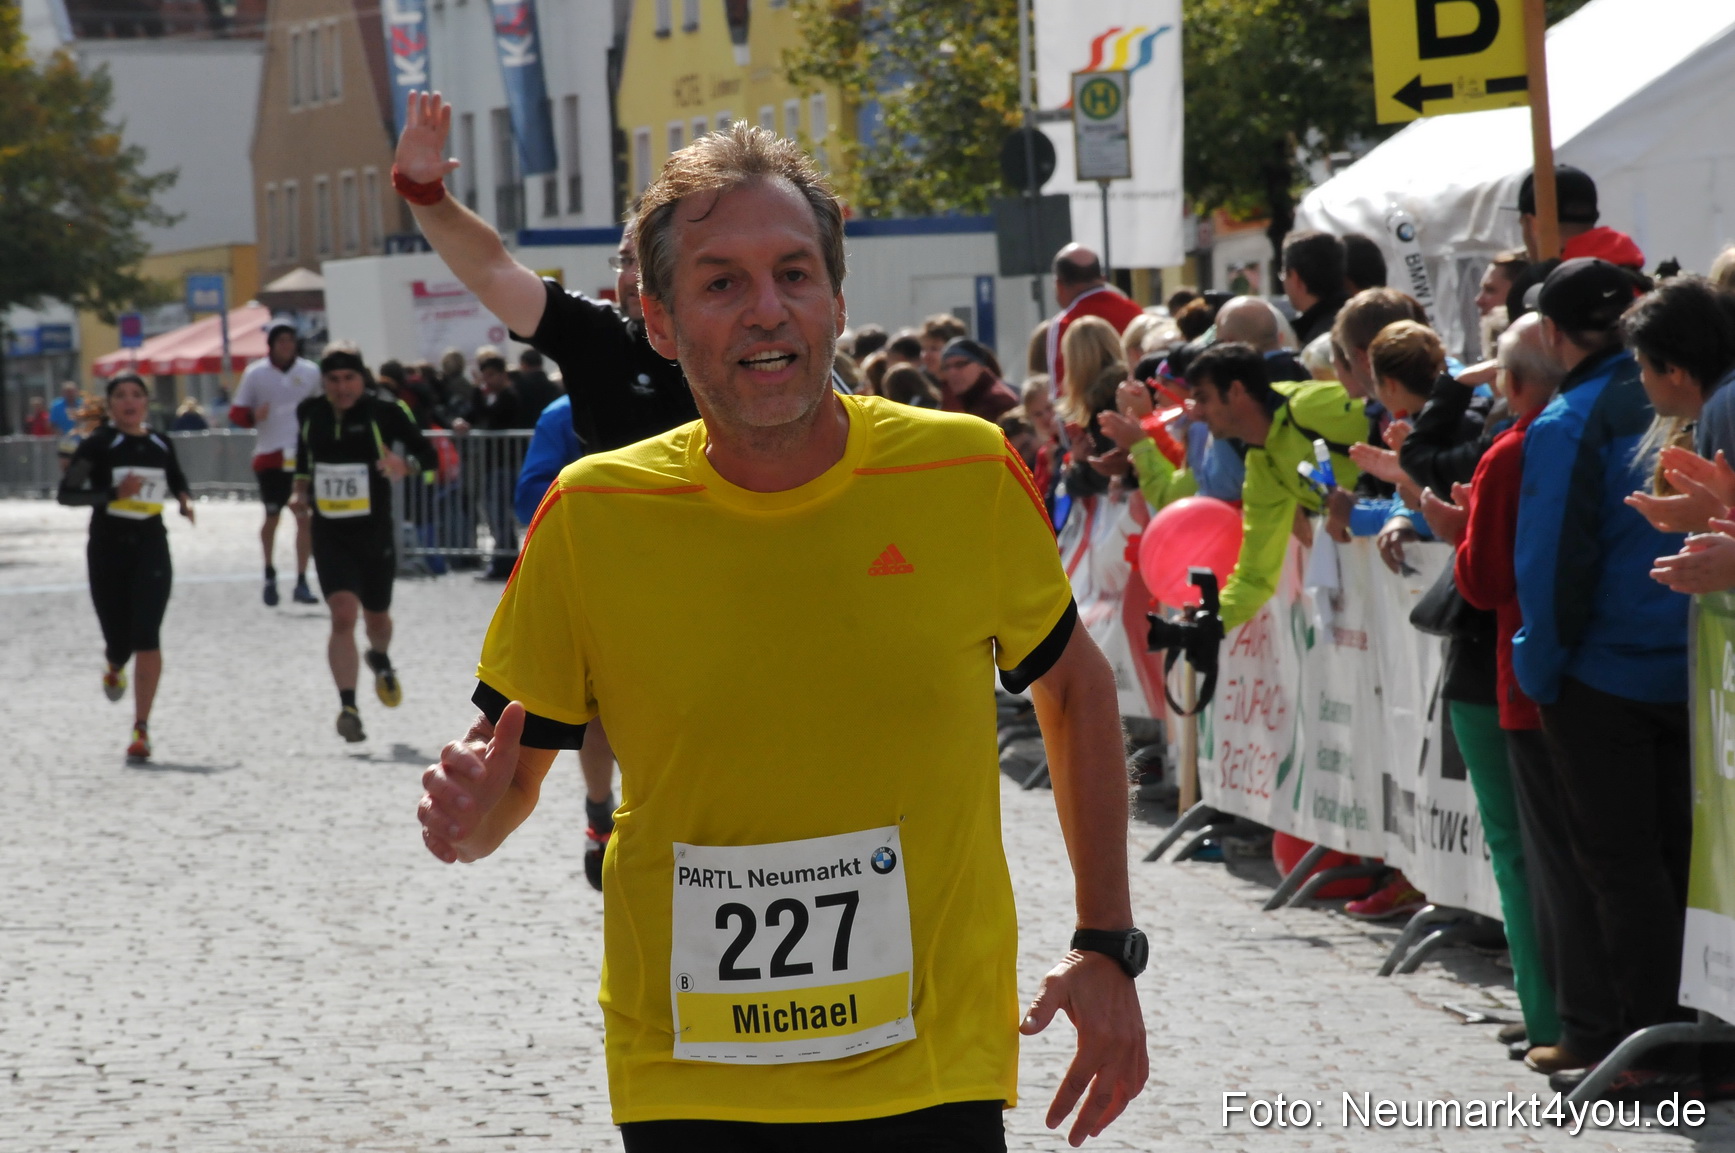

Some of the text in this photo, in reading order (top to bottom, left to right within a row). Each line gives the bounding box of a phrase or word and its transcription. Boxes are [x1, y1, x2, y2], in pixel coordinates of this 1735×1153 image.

[1404, 253, 1431, 298] BMW
[324, 478, 358, 497] 176
[678, 858, 862, 889] PARTL Neumarkt
[715, 890, 859, 981] 227
[681, 976, 689, 989] B
[732, 994, 858, 1034] Michael
